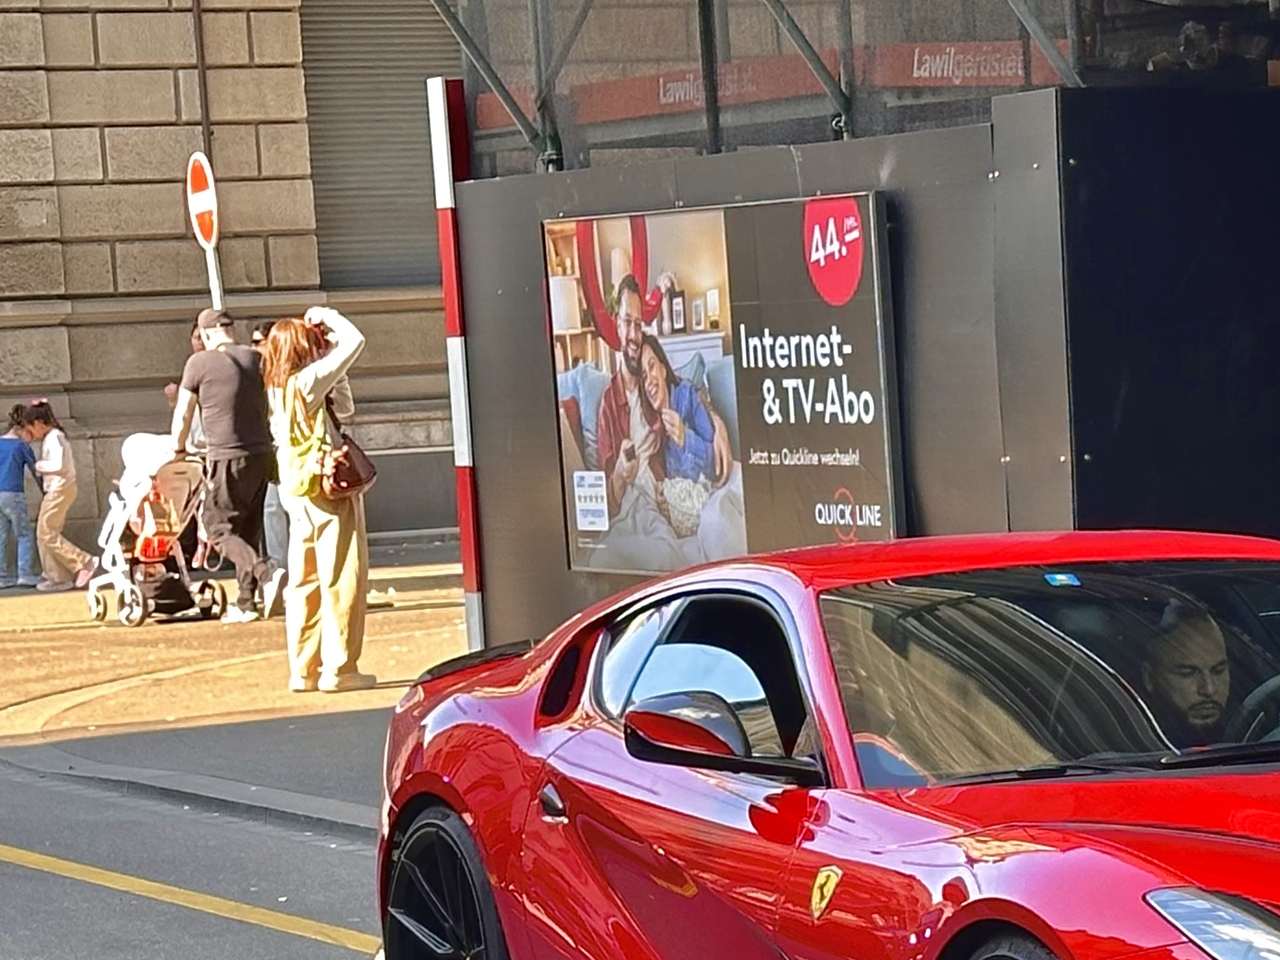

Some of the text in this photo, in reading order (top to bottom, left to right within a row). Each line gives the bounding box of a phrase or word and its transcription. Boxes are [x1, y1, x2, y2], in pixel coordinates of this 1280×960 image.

[740, 323, 853, 368] Internet-
[748, 447, 860, 466] Jetzt zu Quickline wechseln!
[815, 503, 882, 526] QUICK LINE
